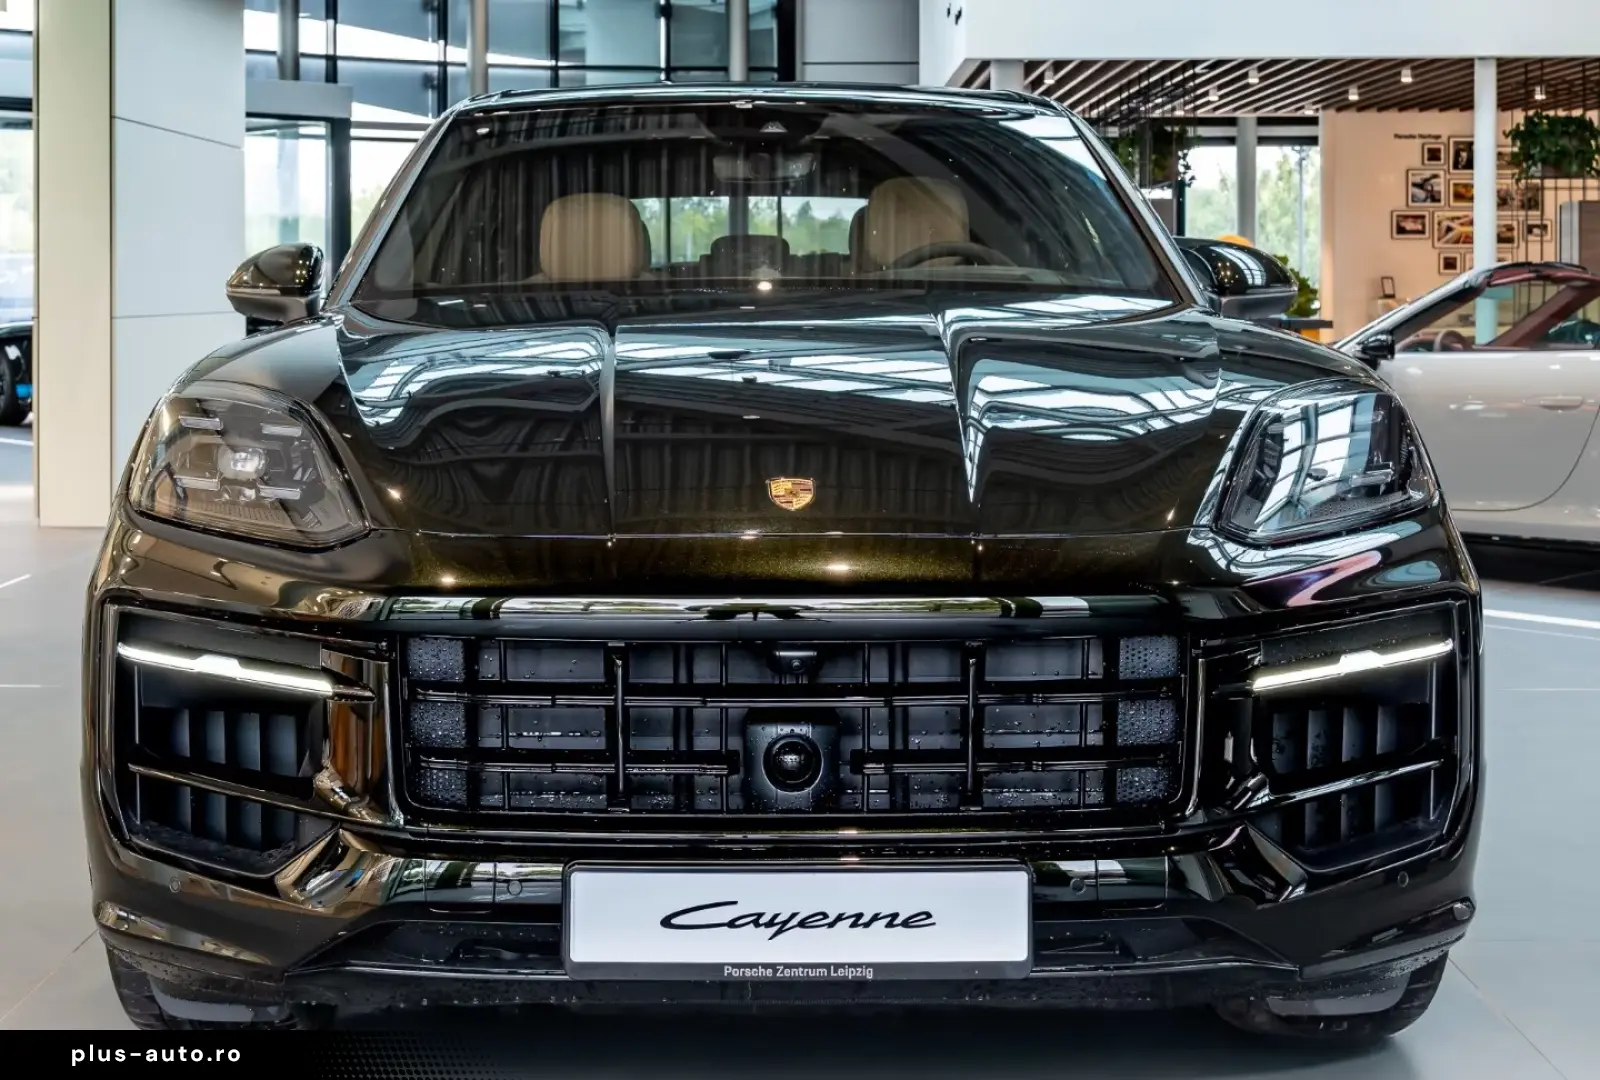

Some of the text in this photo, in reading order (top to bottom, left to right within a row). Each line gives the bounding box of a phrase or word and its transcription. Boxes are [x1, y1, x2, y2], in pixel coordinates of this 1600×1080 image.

[660, 900, 937, 941] Cayenne
[723, 965, 874, 980] Porsche Zentrum Leipzig
